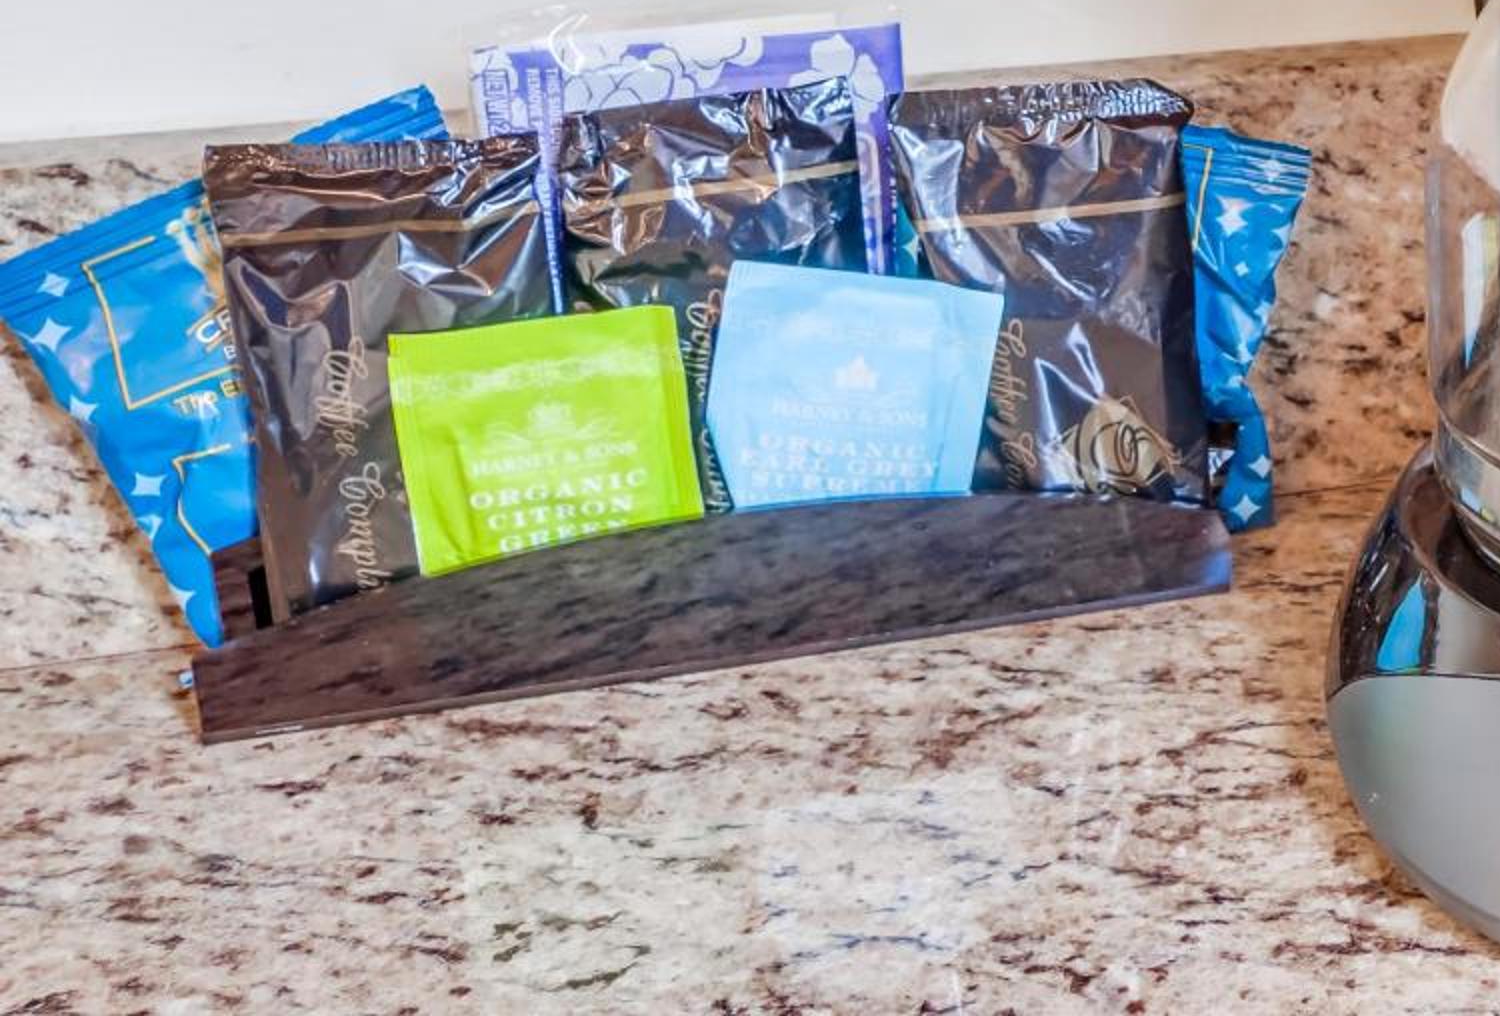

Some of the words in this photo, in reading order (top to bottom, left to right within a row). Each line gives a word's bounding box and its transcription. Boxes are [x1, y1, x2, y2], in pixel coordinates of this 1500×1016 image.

[483, 70, 510, 97] NET
[487, 101, 511, 120] WT
[316, 335, 369, 457] Coffee
[469, 468, 647, 510] ORGANIC
[487, 494, 633, 530] CITRON
